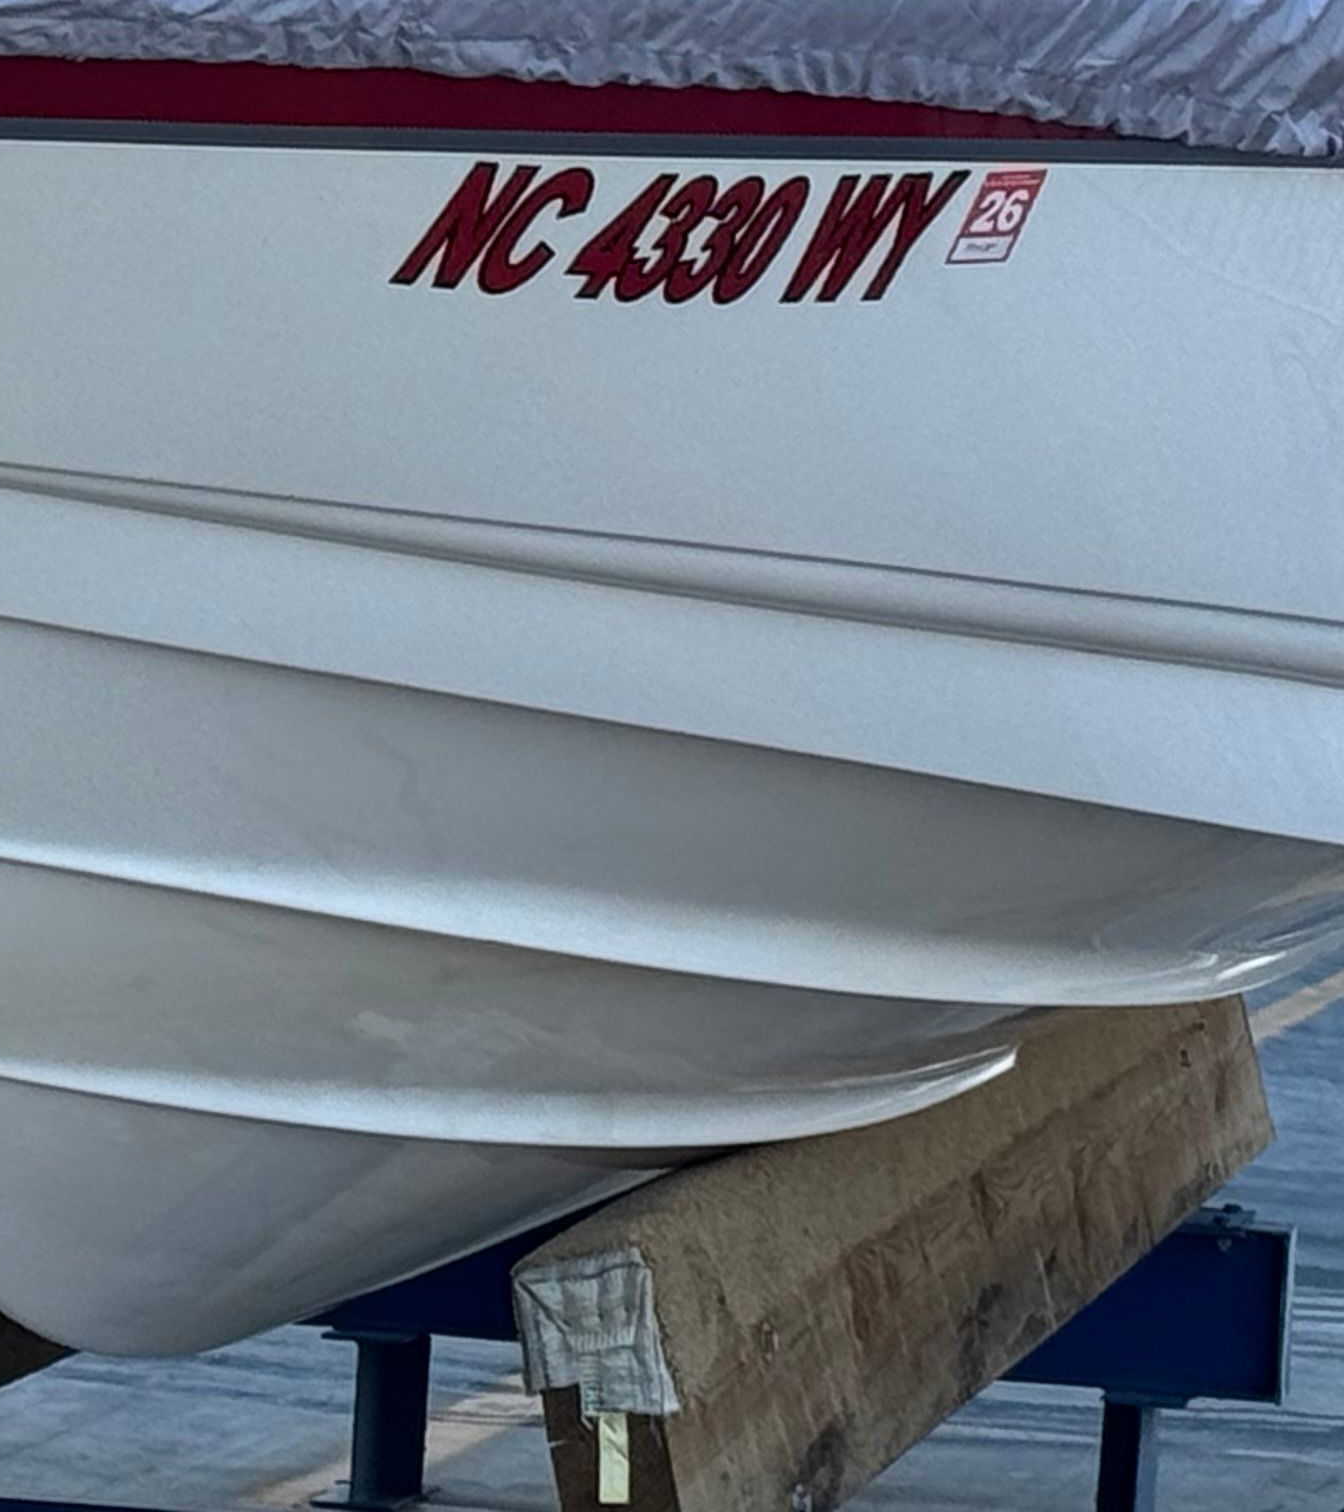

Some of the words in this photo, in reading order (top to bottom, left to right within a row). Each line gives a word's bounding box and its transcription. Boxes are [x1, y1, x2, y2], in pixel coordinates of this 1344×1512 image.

[389, 161, 596, 294] NC
[564, 173, 810, 304] 4330
[778, 169, 972, 304] WY
[968, 189, 1031, 234] 26
